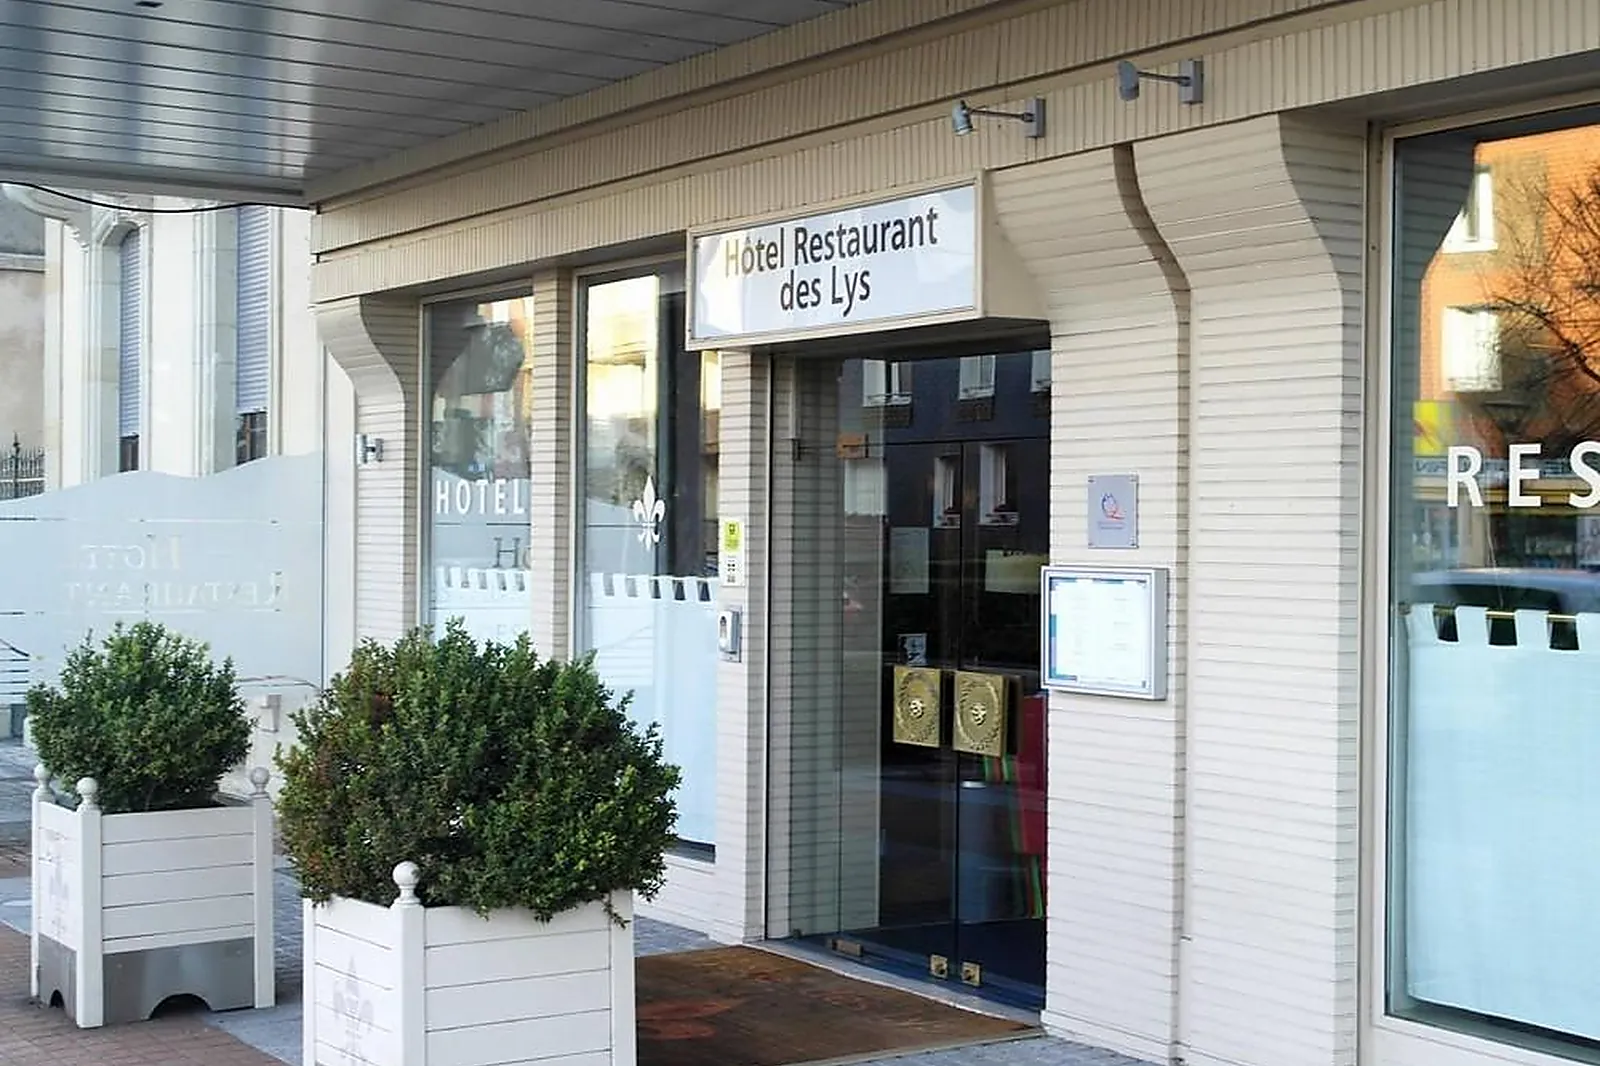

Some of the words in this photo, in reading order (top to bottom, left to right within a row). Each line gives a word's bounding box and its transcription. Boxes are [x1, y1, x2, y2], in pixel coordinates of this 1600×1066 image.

[724, 227, 785, 278] Hôtel
[794, 207, 938, 267] Restaurant
[780, 269, 821, 311] des
[831, 265, 871, 317] Lys
[436, 479, 525, 515] HOTEL
[1447, 441, 1600, 508] RES
